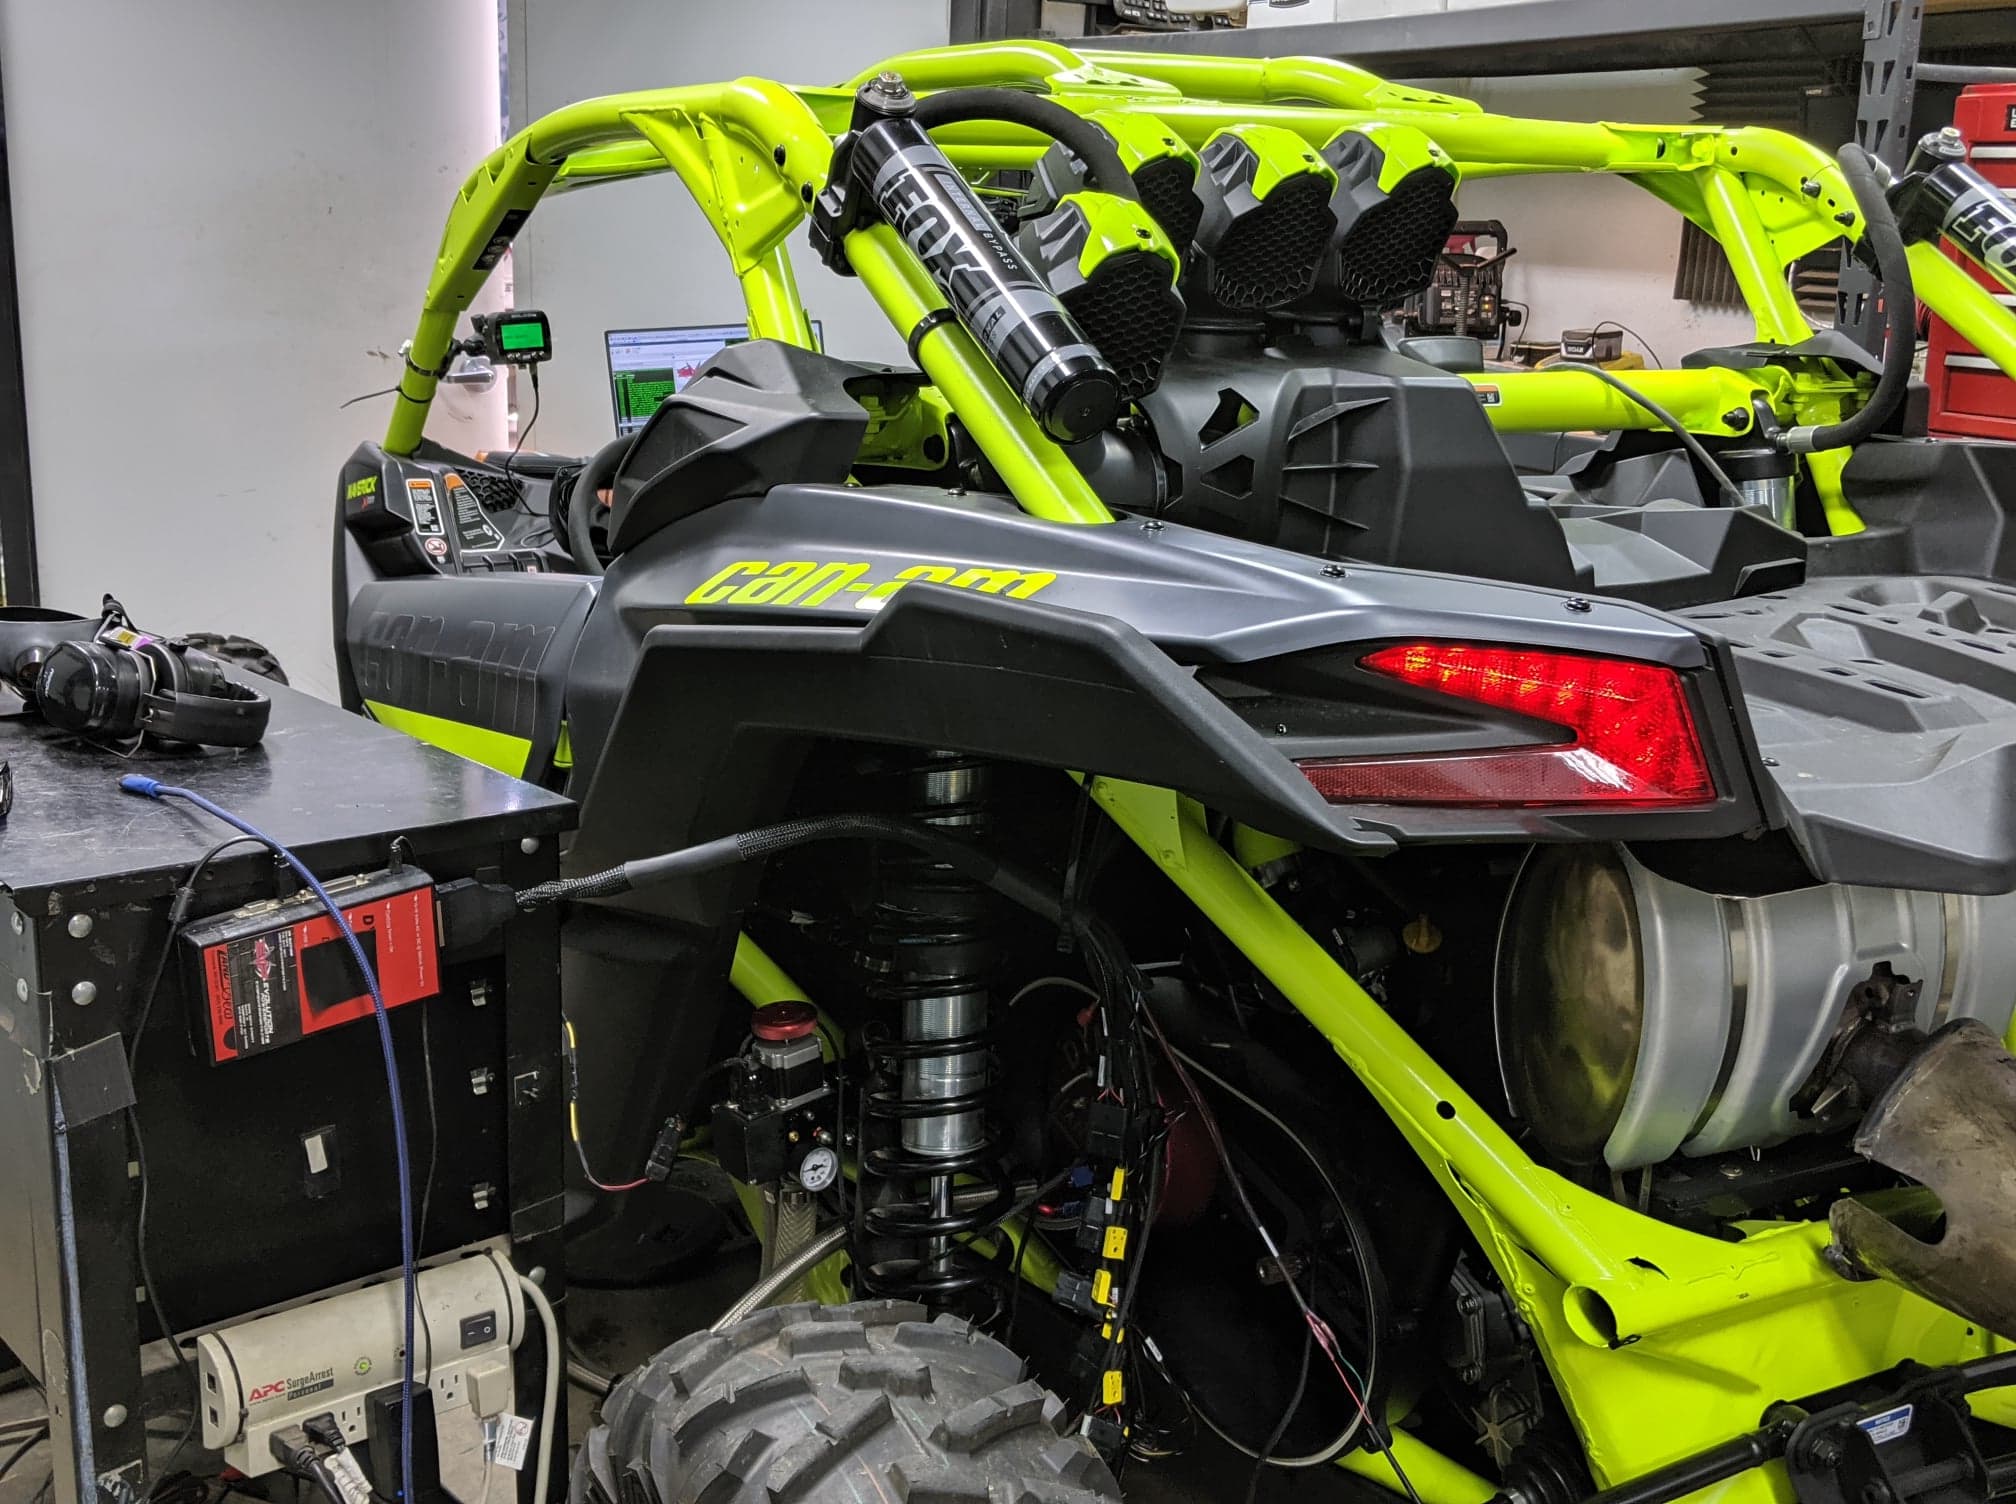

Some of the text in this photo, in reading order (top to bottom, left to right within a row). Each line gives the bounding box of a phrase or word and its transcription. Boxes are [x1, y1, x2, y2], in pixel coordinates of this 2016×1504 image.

[942, 174, 1019, 271] INTERNAL BYPASS
[1952, 201, 2016, 269] FO
[249, 1380, 285, 1402] APC
[286, 1368, 334, 1389] SurgeArrest
